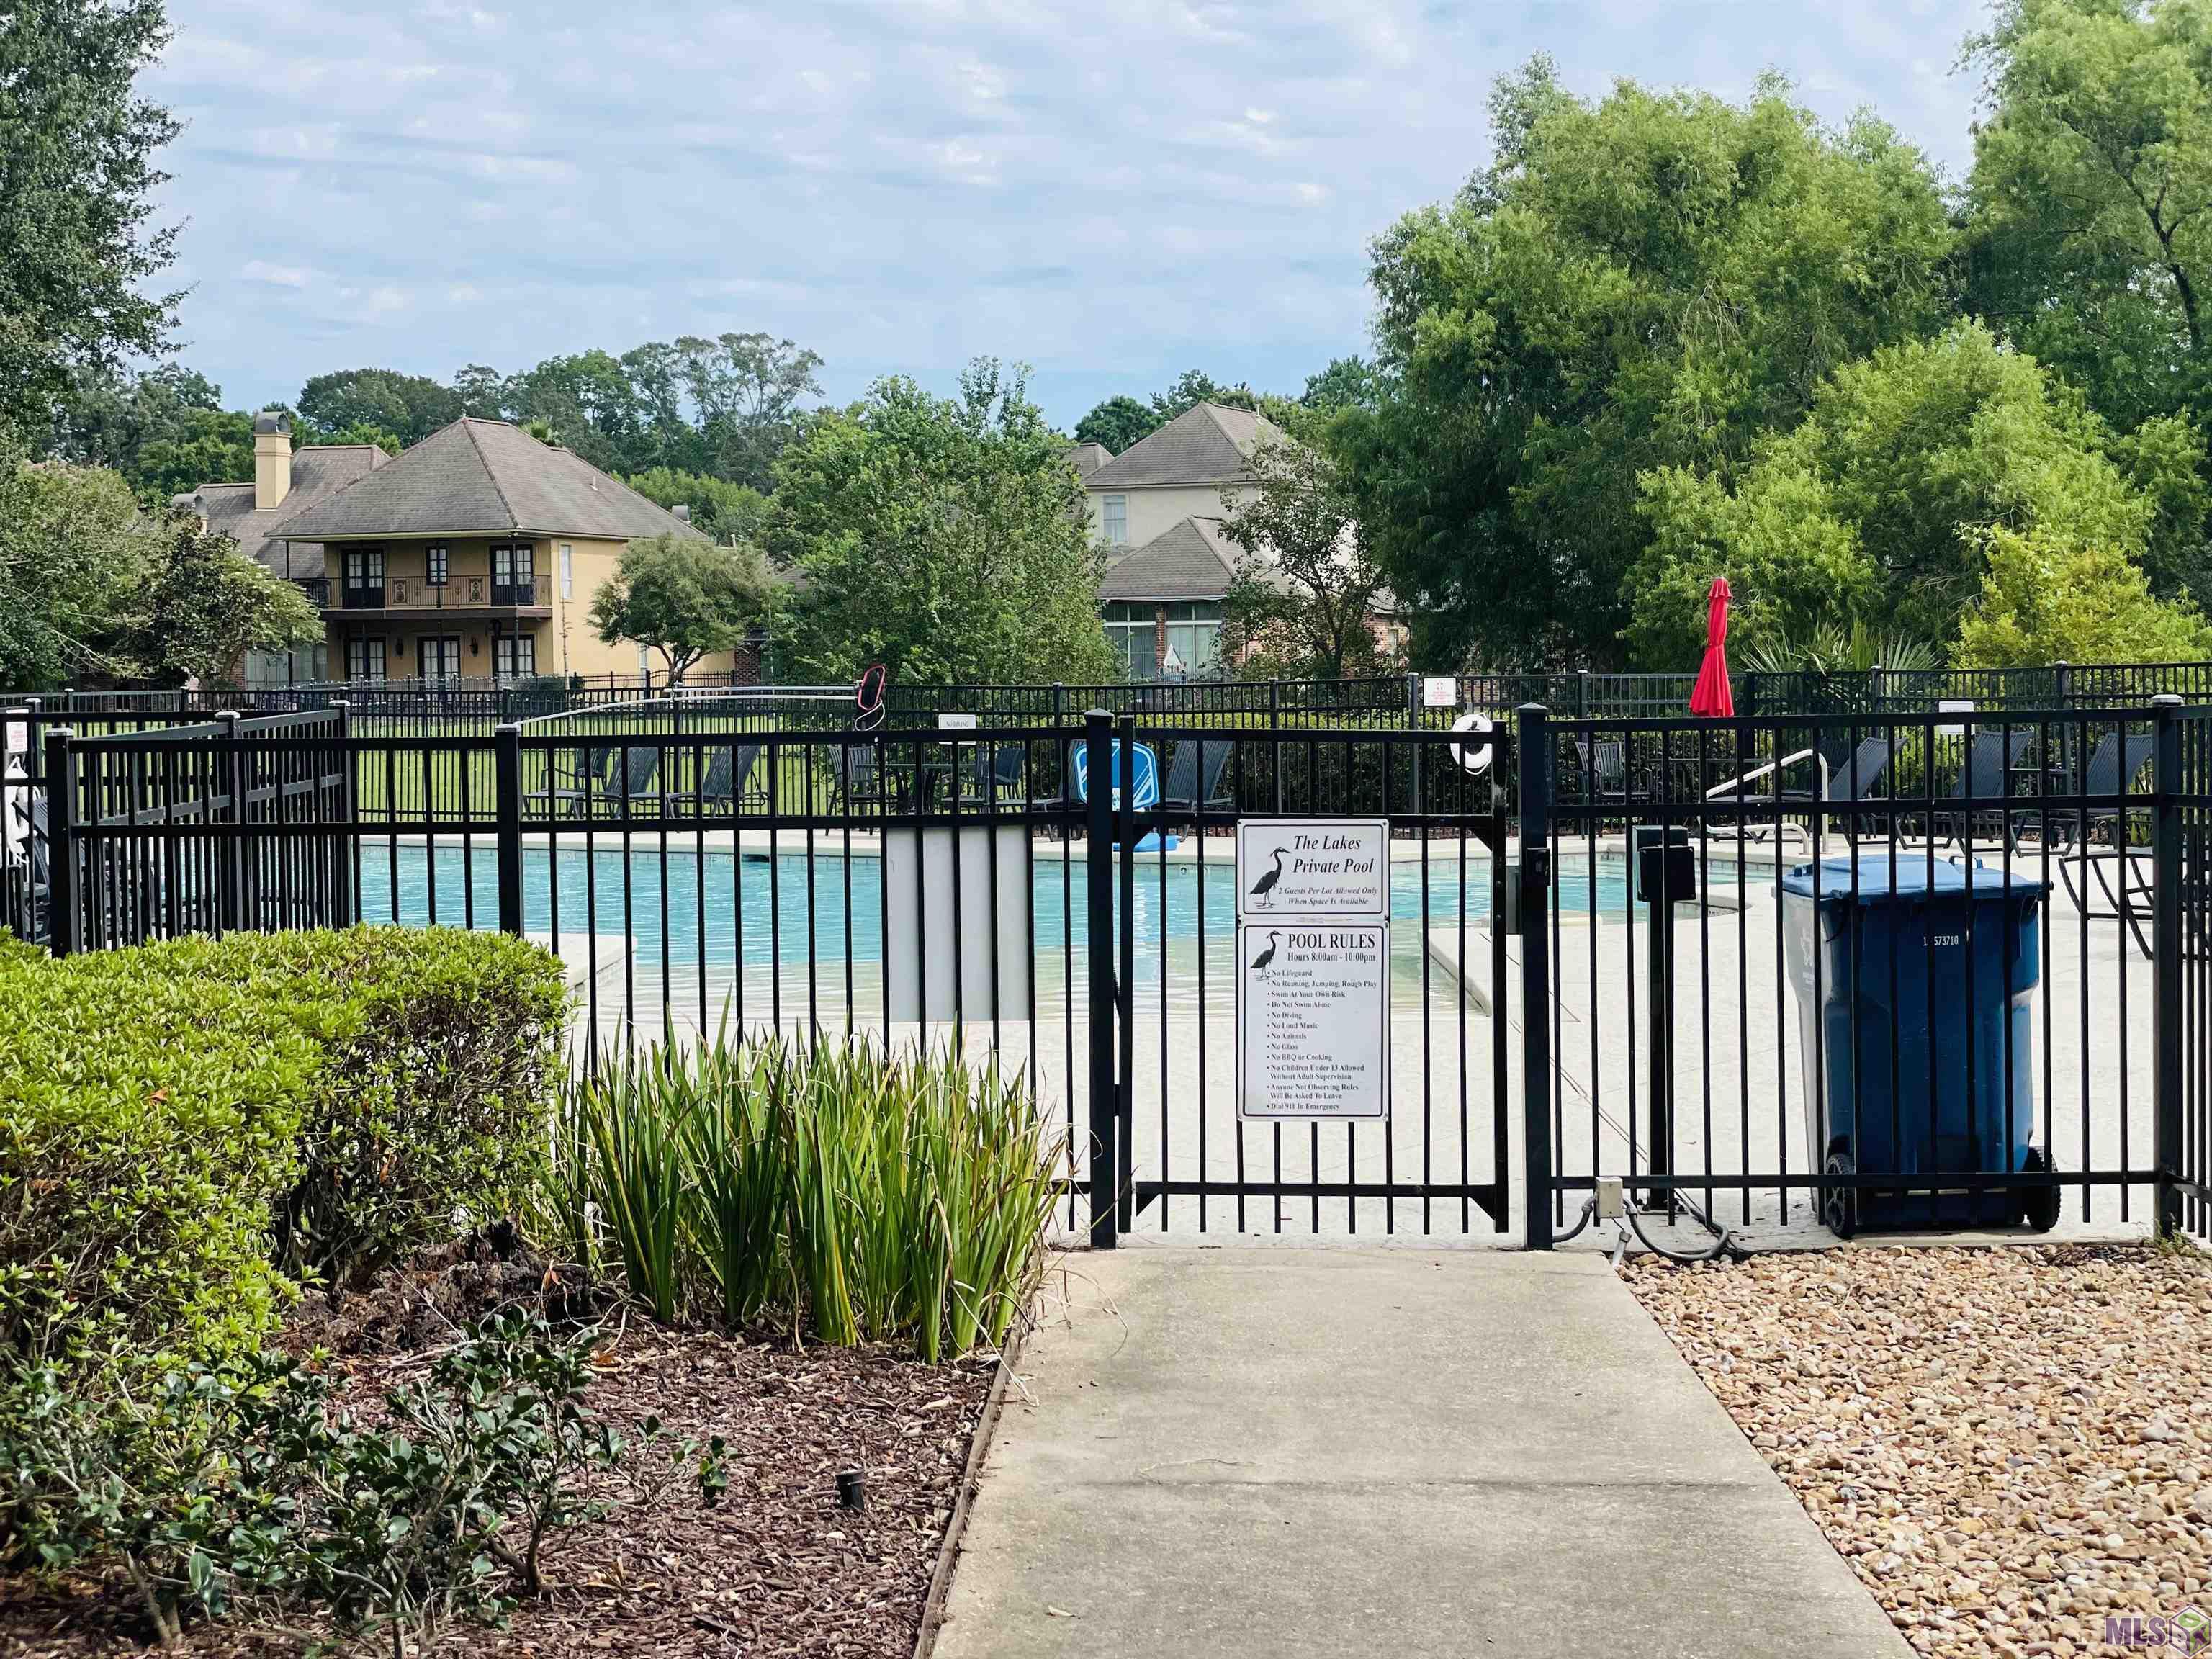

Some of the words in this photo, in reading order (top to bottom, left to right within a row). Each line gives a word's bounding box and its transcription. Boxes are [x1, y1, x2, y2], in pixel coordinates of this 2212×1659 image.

[1295, 835, 1318, 850] The
[1322, 835, 1361, 850] Lakes
[1293, 858, 1339, 873] Private
[1344, 858, 1374, 873] Pool
[1288, 933, 1326, 948] POOL
[1330, 933, 1375, 948] RULES
[1934, 935, 1959, 945] 573710
[1288, 952, 1310, 961] Hours
[1311, 952, 1337, 961] 8:00am
[1345, 953, 1375, 963] 10:00pm
[1342, 979, 1362, 988] Rough
